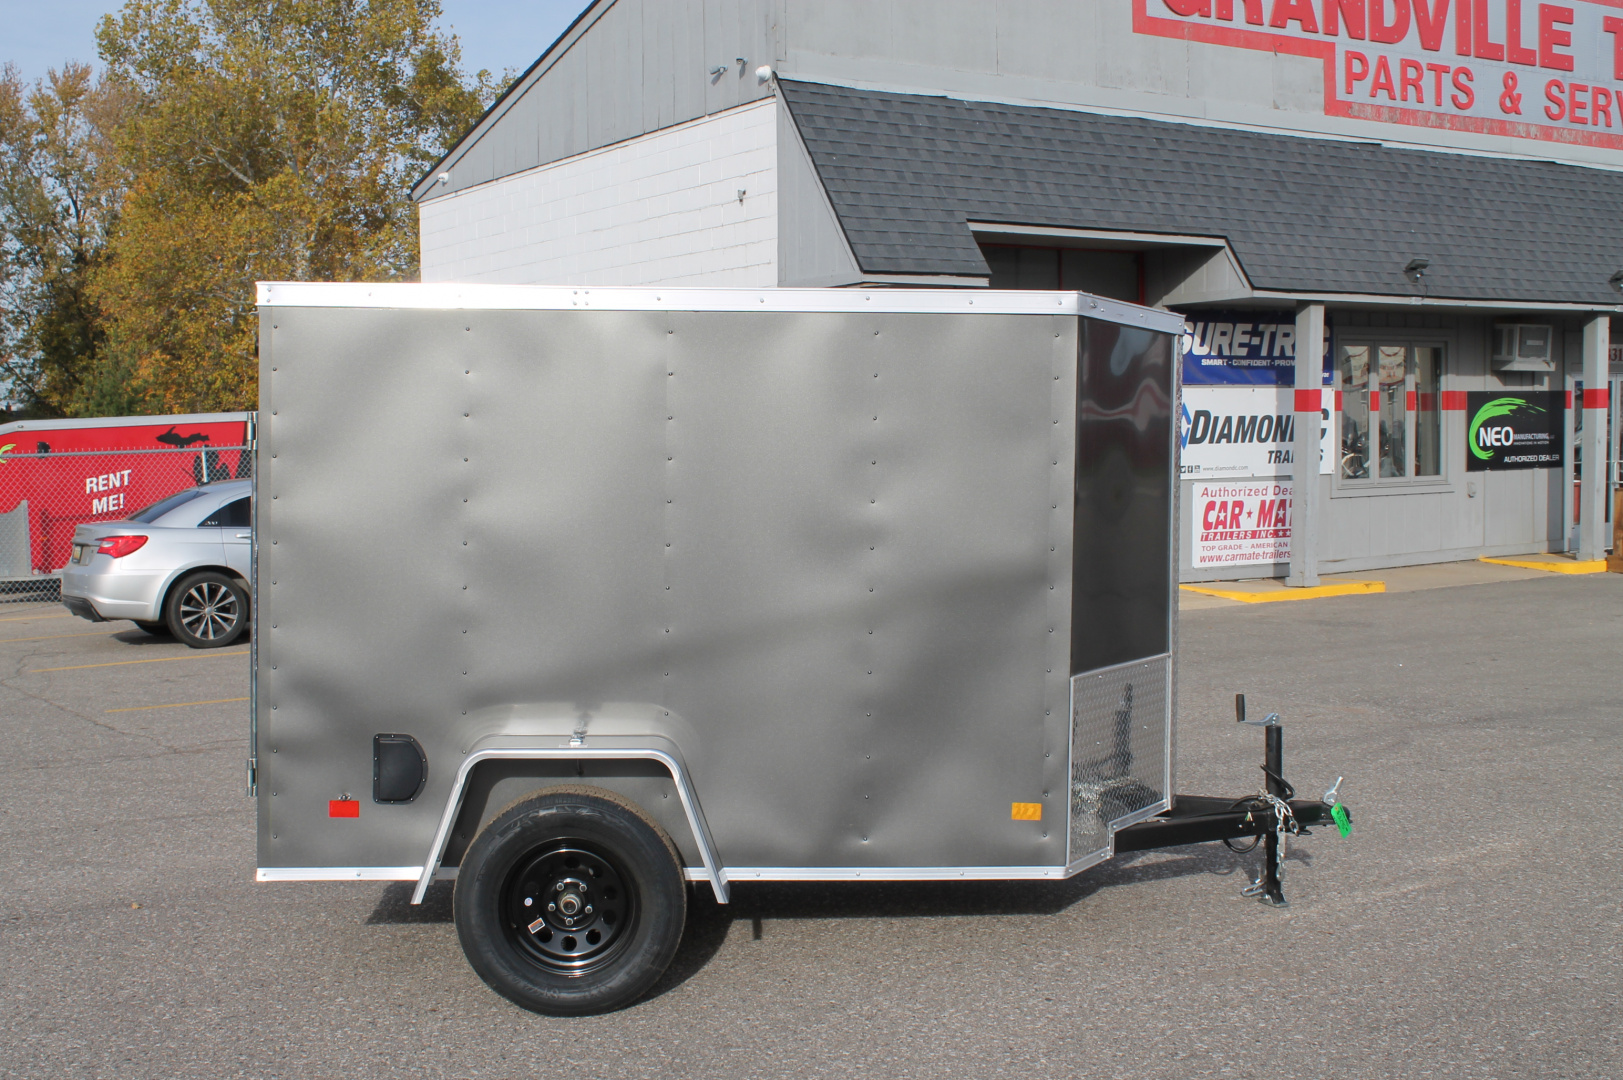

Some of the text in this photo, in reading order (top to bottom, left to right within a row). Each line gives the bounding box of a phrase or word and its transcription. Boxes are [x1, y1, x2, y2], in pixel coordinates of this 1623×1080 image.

[1344, 50, 1475, 110] PARTS
[1499, 71, 1523, 115] &
[1609, 348, 1623, 361] 31
[1479, 426, 1514, 447] NEO
[85, 469, 132, 495] RENT
[1200, 485, 1268, 498] Authorized
[92, 493, 124, 515] ME!
[1202, 500, 1245, 531] CAR
[1201, 529, 1277, 541] TRAILERS INC.
[1217, 543, 1243, 551] GRADE
[1250, 541, 1289, 550] AMERICAN
